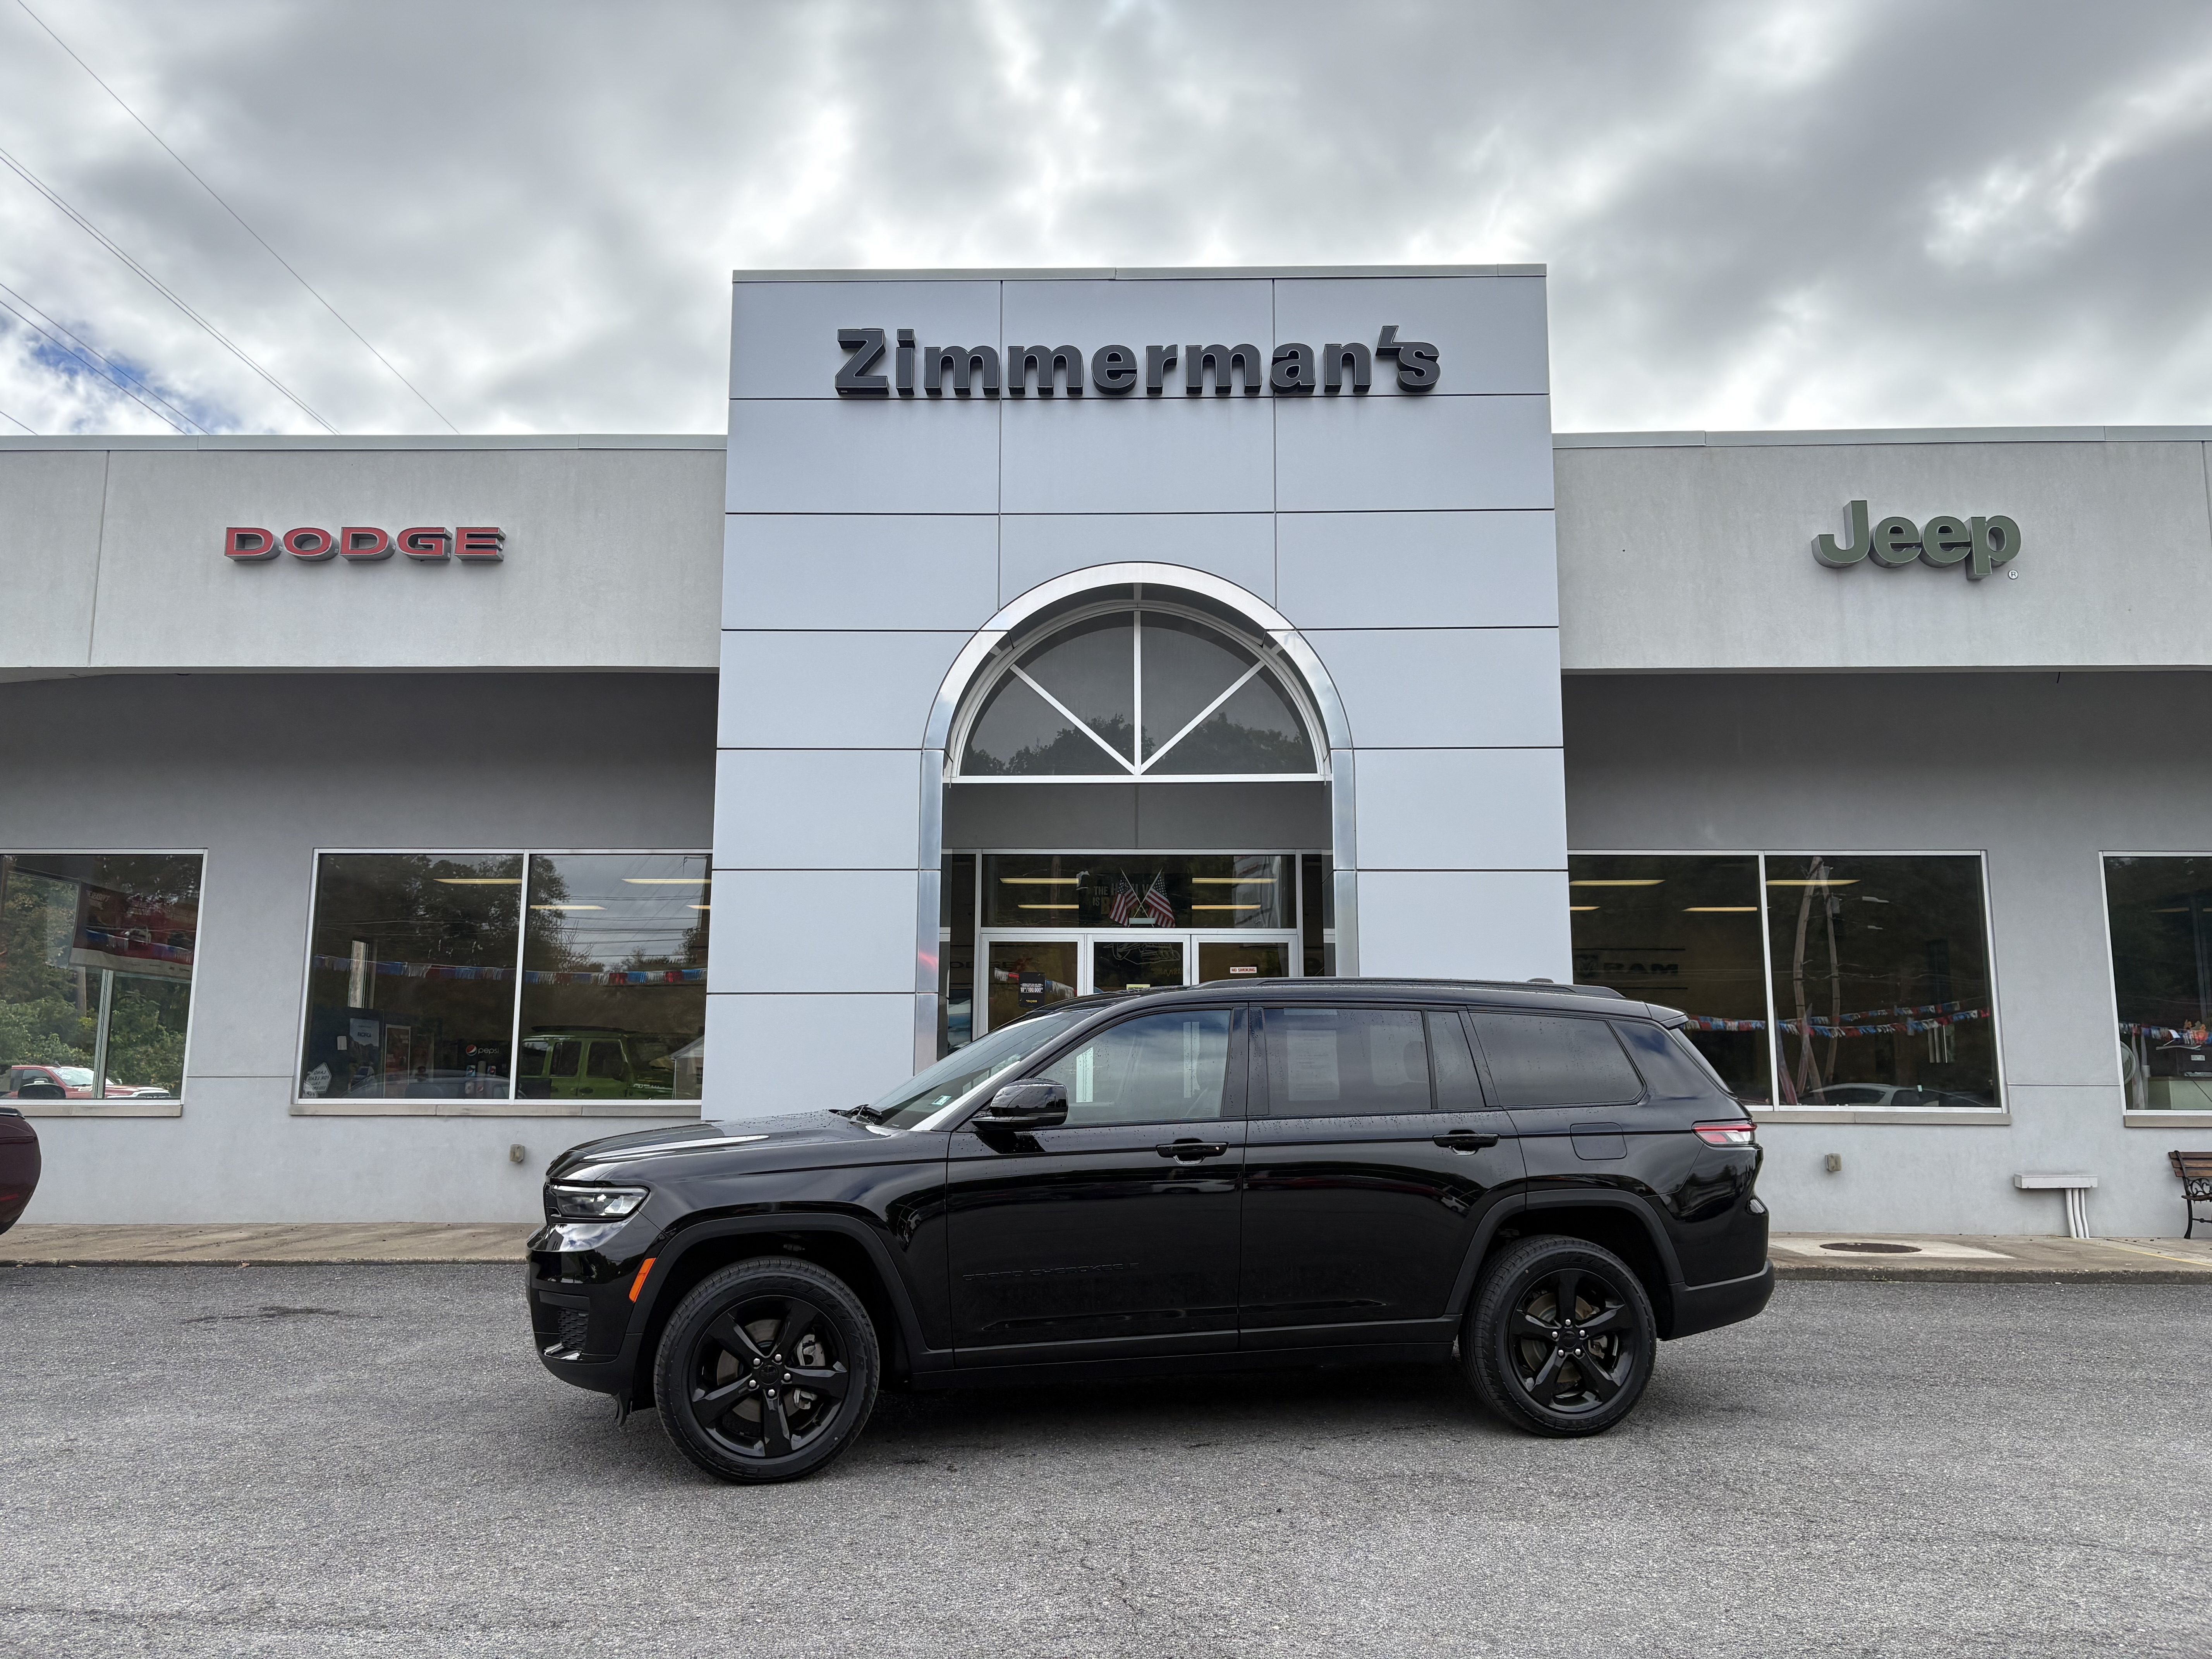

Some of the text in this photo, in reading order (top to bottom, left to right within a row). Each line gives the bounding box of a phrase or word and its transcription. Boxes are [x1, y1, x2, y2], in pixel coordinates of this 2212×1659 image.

[835, 325, 1441, 393] Zimmerman's
[224, 527, 506, 561] DODGE
[1811, 500, 2021, 580] Jeep
[1094, 886, 1108, 895] THE
[1604, 962, 1678, 974] RAM
[962, 1270, 1024, 1281] GRAND
[1030, 1264, 1123, 1275] CHEROKEE
